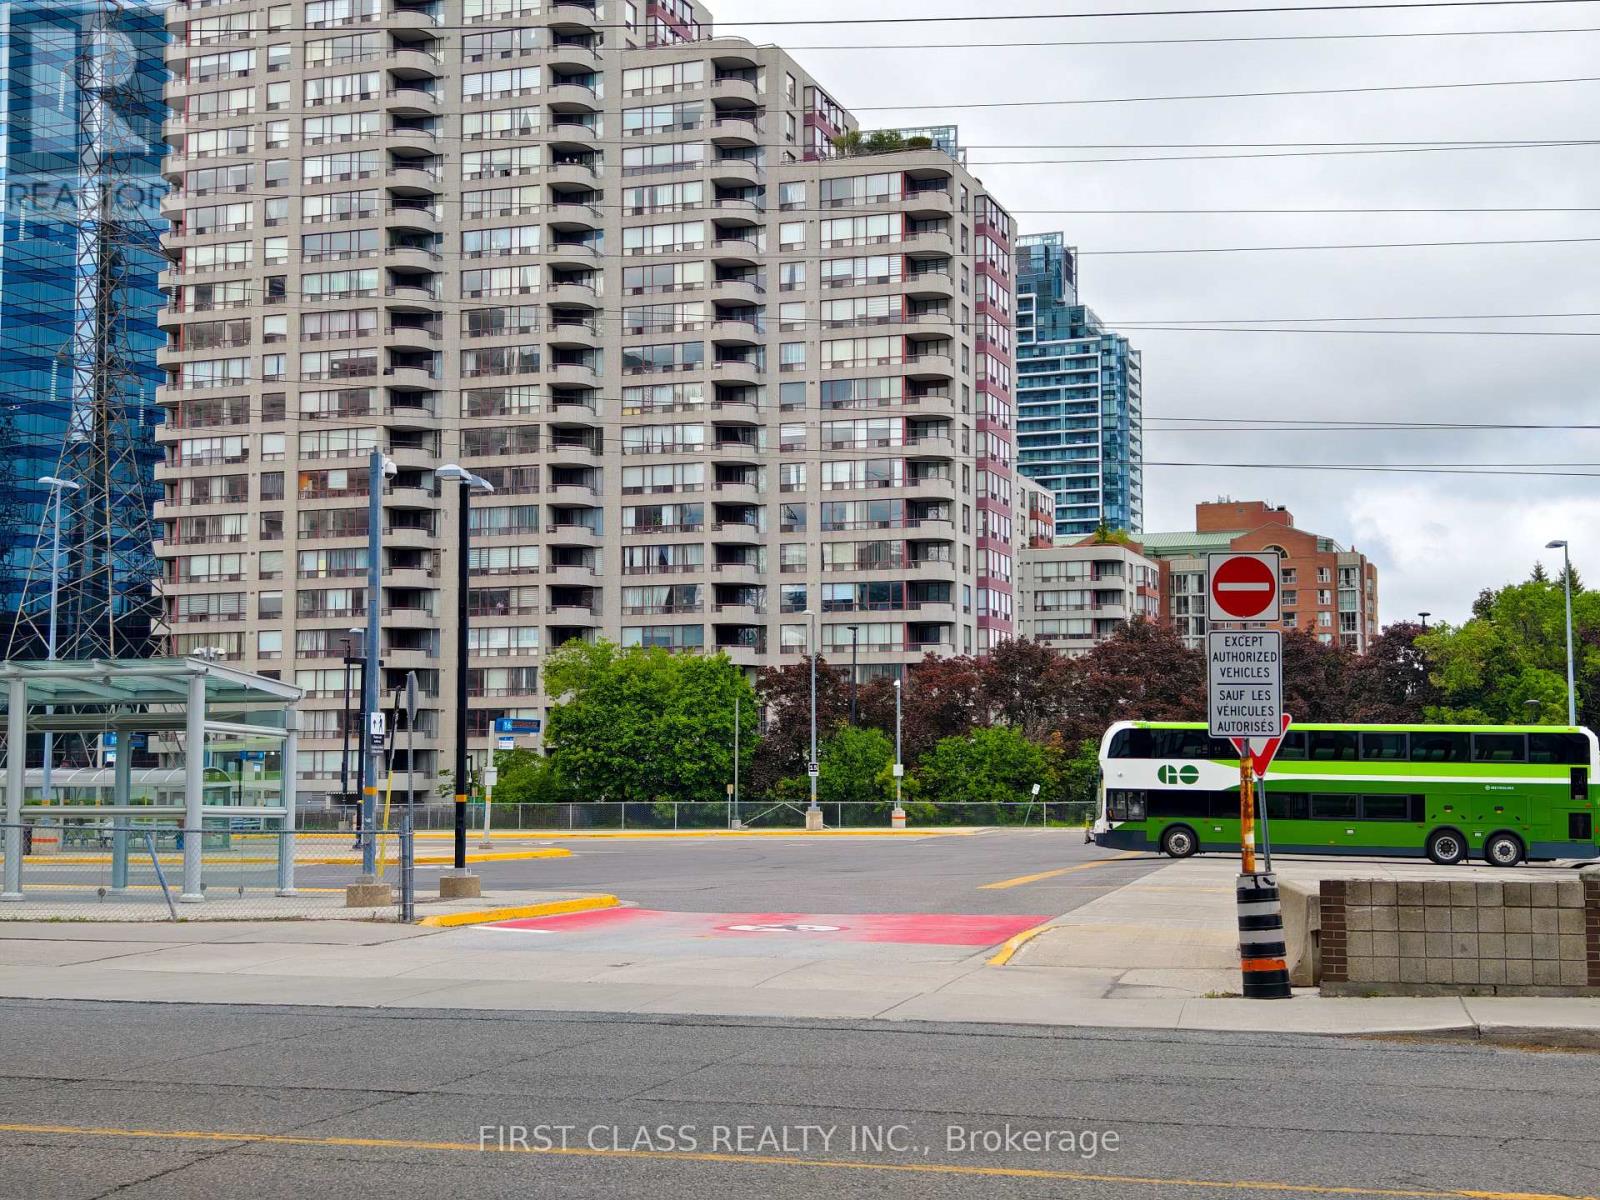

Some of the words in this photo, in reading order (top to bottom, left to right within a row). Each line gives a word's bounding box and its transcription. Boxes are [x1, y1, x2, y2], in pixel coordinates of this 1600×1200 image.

[1224, 636, 1264, 647] EXCEPT
[1212, 651, 1277, 663] AUTHORIZED
[1219, 667, 1270, 678] VEHICLES
[1219, 689, 1246, 701] SAUF
[1251, 689, 1271, 701] LES
[1216, 703, 1274, 717] VÉHICULES
[1217, 718, 1274, 732] AUTORISÉS
[1157, 764, 1200, 785] GO
